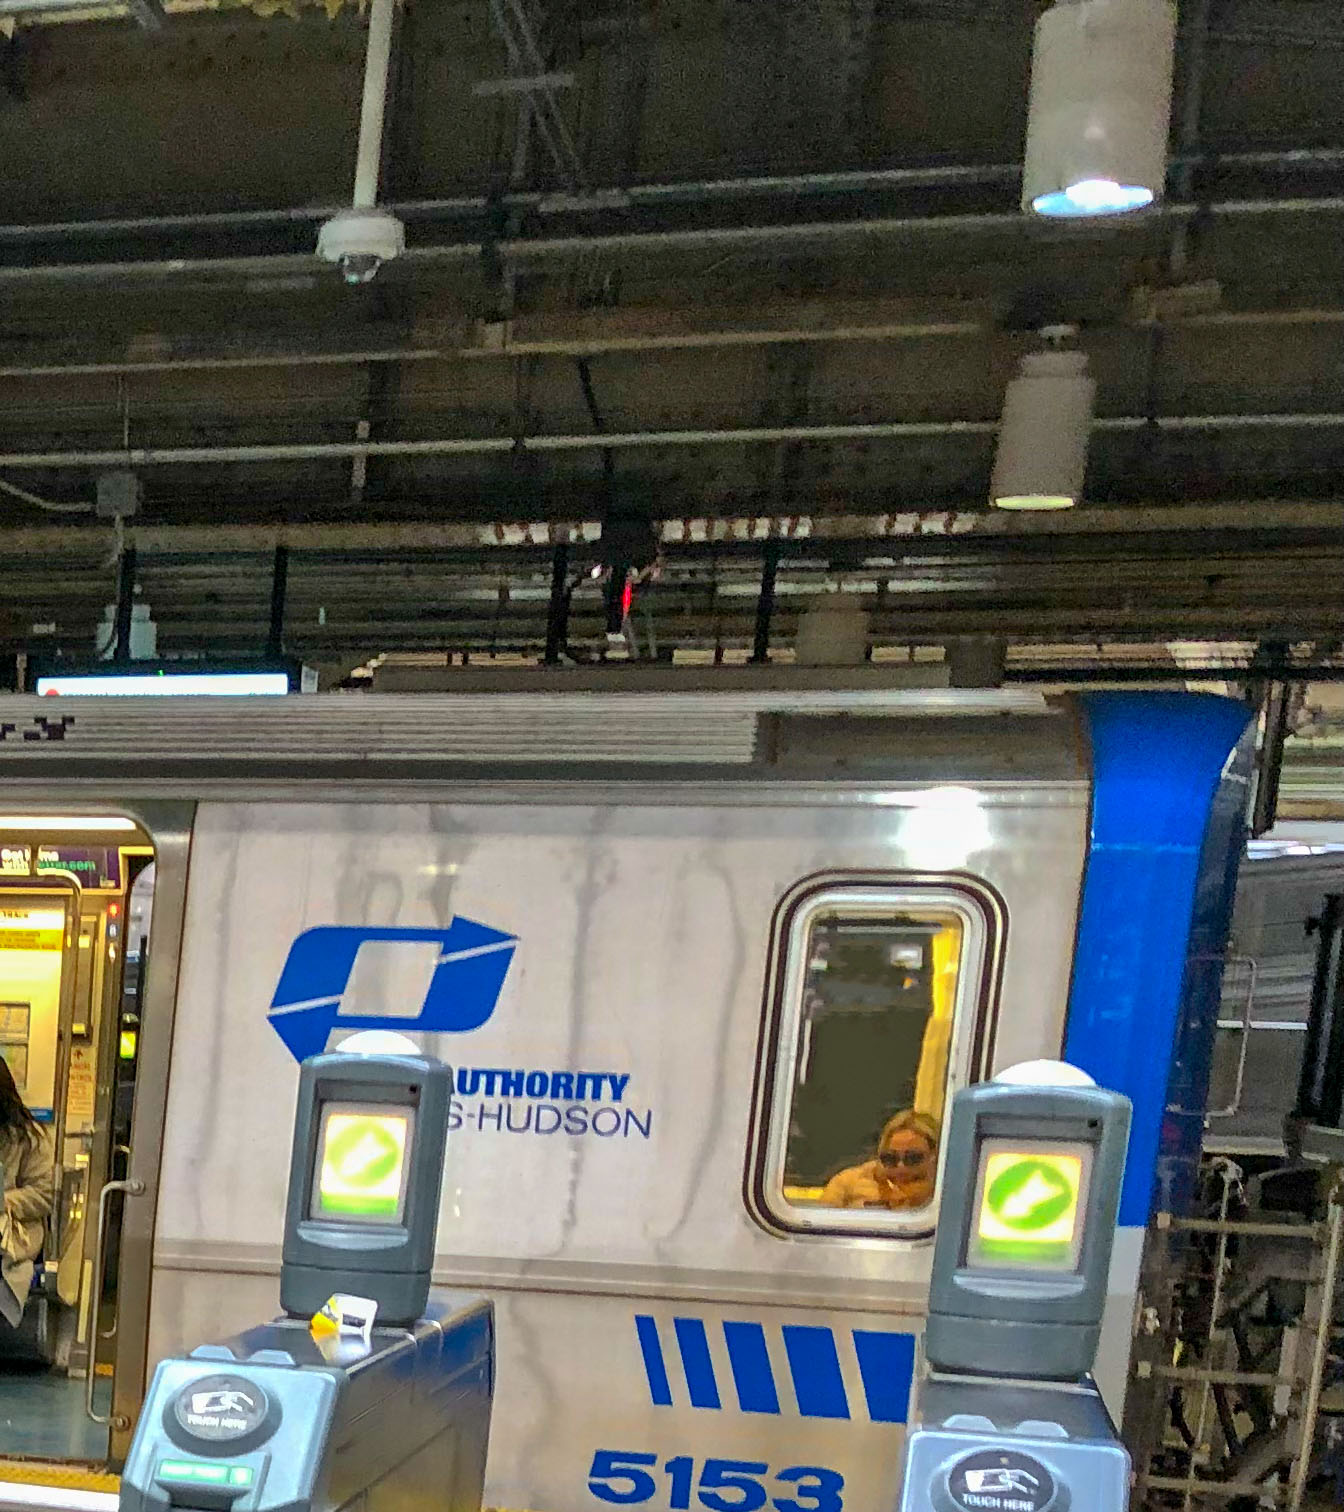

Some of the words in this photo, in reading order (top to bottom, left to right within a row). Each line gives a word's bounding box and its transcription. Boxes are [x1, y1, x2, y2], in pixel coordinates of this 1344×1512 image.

[450, 1068, 630, 1102] UTHORITY
[962, 1493, 1001, 1509] TOUCH
[1003, 1499, 1035, 1512] HERE
